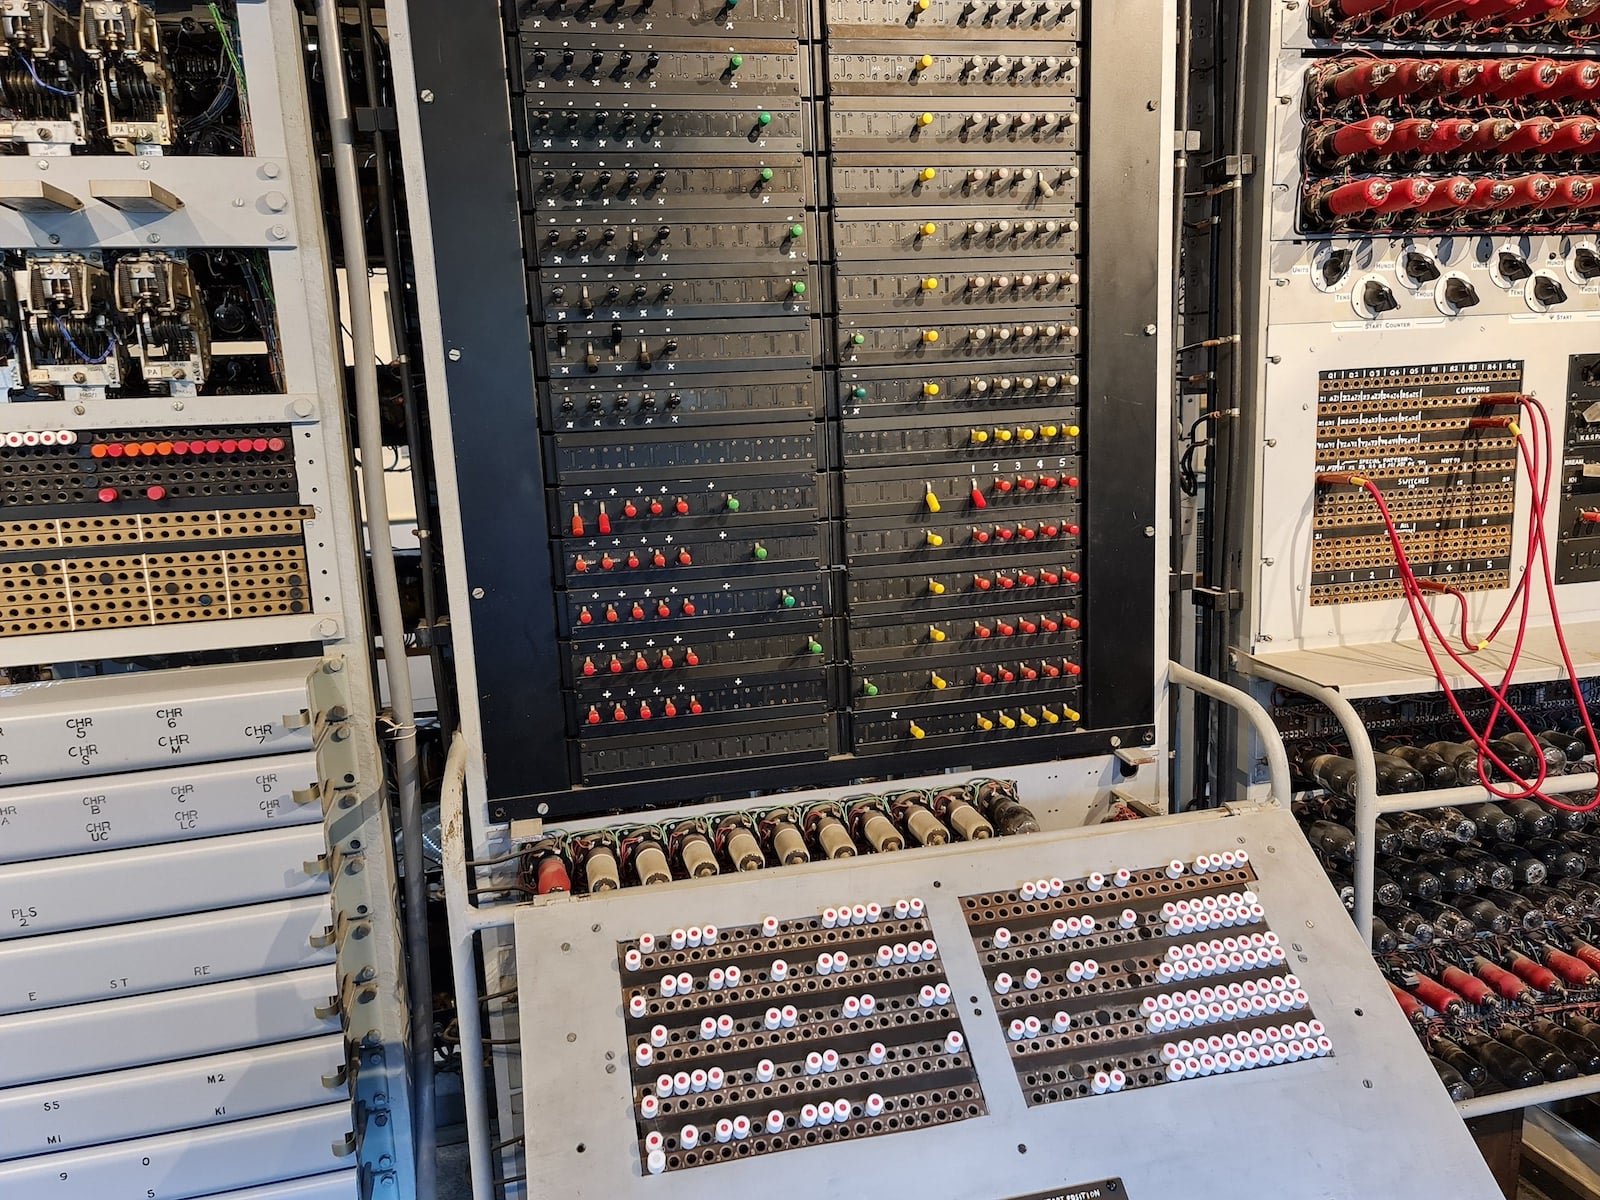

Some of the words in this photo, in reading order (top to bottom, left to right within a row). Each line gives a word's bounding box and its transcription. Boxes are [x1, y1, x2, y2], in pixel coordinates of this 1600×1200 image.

[1456, 386, 1490, 394] COMMONS
[1037, 460, 1043, 468] 4
[1060, 458, 1065, 466] 5
[1398, 477, 1430, 485] SWITCHES
[1446, 564, 1453, 572] 4
[1487, 560, 1493, 568] 5
[156, 708, 182, 719] CHR
[66, 718, 92, 729] CHR
[168, 718, 176, 728] 6
[77, 728, 86, 738] 5
[245, 725, 272, 736] CHR
[158, 735, 189, 746] CHR
[69, 745, 98, 756] CHR
[256, 774, 277, 784] CHR
[171, 785, 194, 795] CHR
[263, 784, 271, 792] D
[83, 796, 106, 806] CHR
[260, 800, 280, 810] CHR
[91, 805, 100, 814] B
[267, 810, 274, 818] E
[175, 810, 198, 820] CHR
[2, 818, 9, 826] A
[86, 822, 111, 832] CHR
[180, 820, 196, 829] LC
[92, 832, 108, 841] UC
[12, 907, 37, 918] PLS
[194, 966, 210, 976] RE
[29, 992, 36, 1001] E
[1066, 1189, 1100, 1200] POSITION
